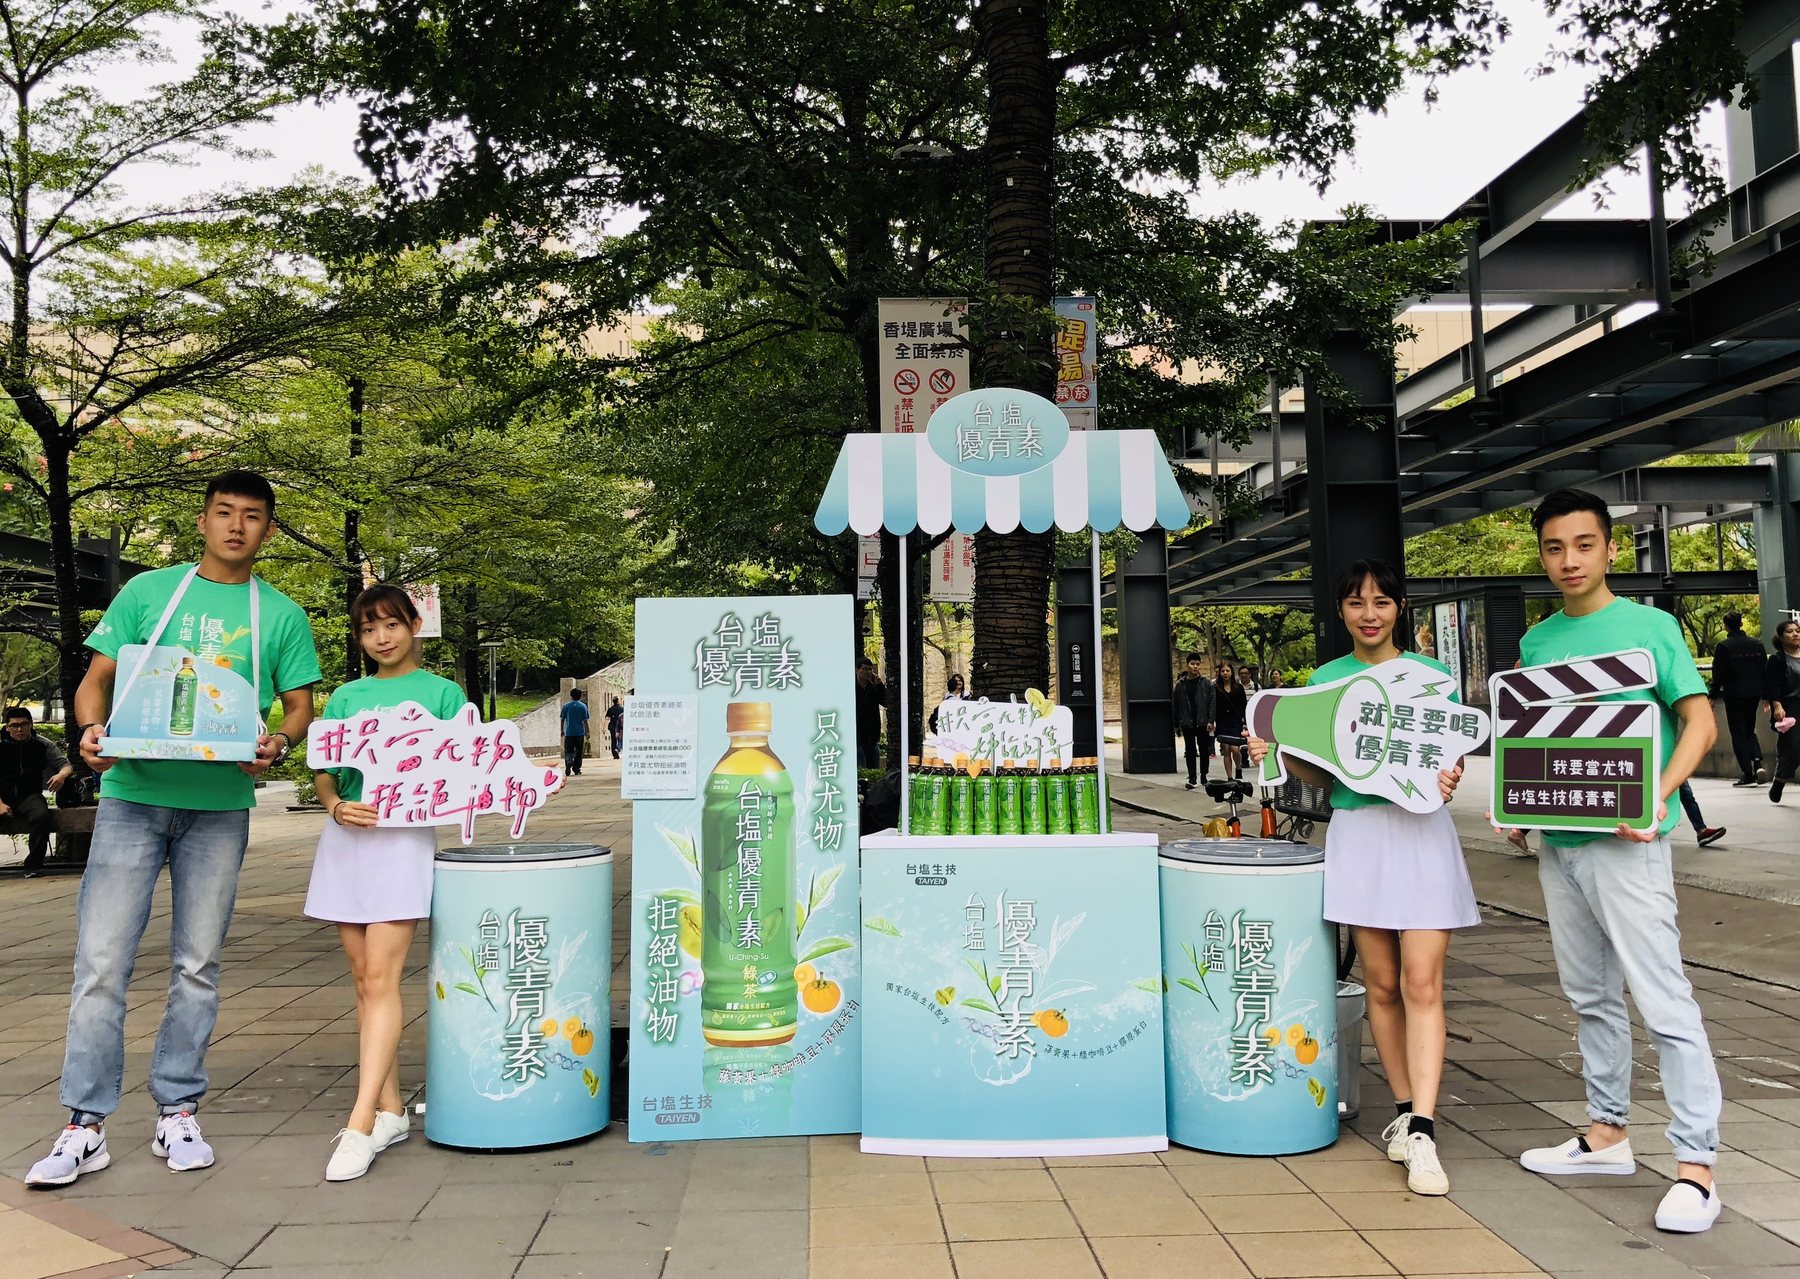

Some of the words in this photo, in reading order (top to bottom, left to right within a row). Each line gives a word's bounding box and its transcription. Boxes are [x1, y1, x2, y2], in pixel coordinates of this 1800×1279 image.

[883, 321, 953, 339] 香堤廣場
[973, 401, 1023, 427] 台塩
[956, 417, 1044, 463] 優青素
[178, 612, 195, 642] 台塩
[715, 611, 781, 648] 台塩
[693, 638, 803, 697] 優青素
[629, 710, 660, 718] 試飲活動
[1358, 701, 1479, 740] 就是要喝
[1355, 734, 1444, 770] 優青素
[1552, 759, 1634, 777] 我要當尤物
[812, 711, 845, 851] 只當尤物
[1507, 789, 1616, 808] 台塩生技優青素
[735, 779, 763, 949] 台塩優青素
[906, 863, 957, 876] 台塩生技
[918, 877, 945, 886] TAIYEN
[477, 908, 501, 971] 台塩
[962, 891, 986, 951] 台塩
[1202, 909, 1226, 973] 台塩
[647, 897, 680, 1043] 拒絕油物
[741, 964, 758, 1000] 綠茶
[993, 889, 1038, 1059] 優青素
[502, 908, 553, 1082] 優青素
[1229, 911, 1278, 1086] 優青素
[642, 1093, 713, 1112] 台塩生技
[659, 1113, 698, 1124] TAIYEN
